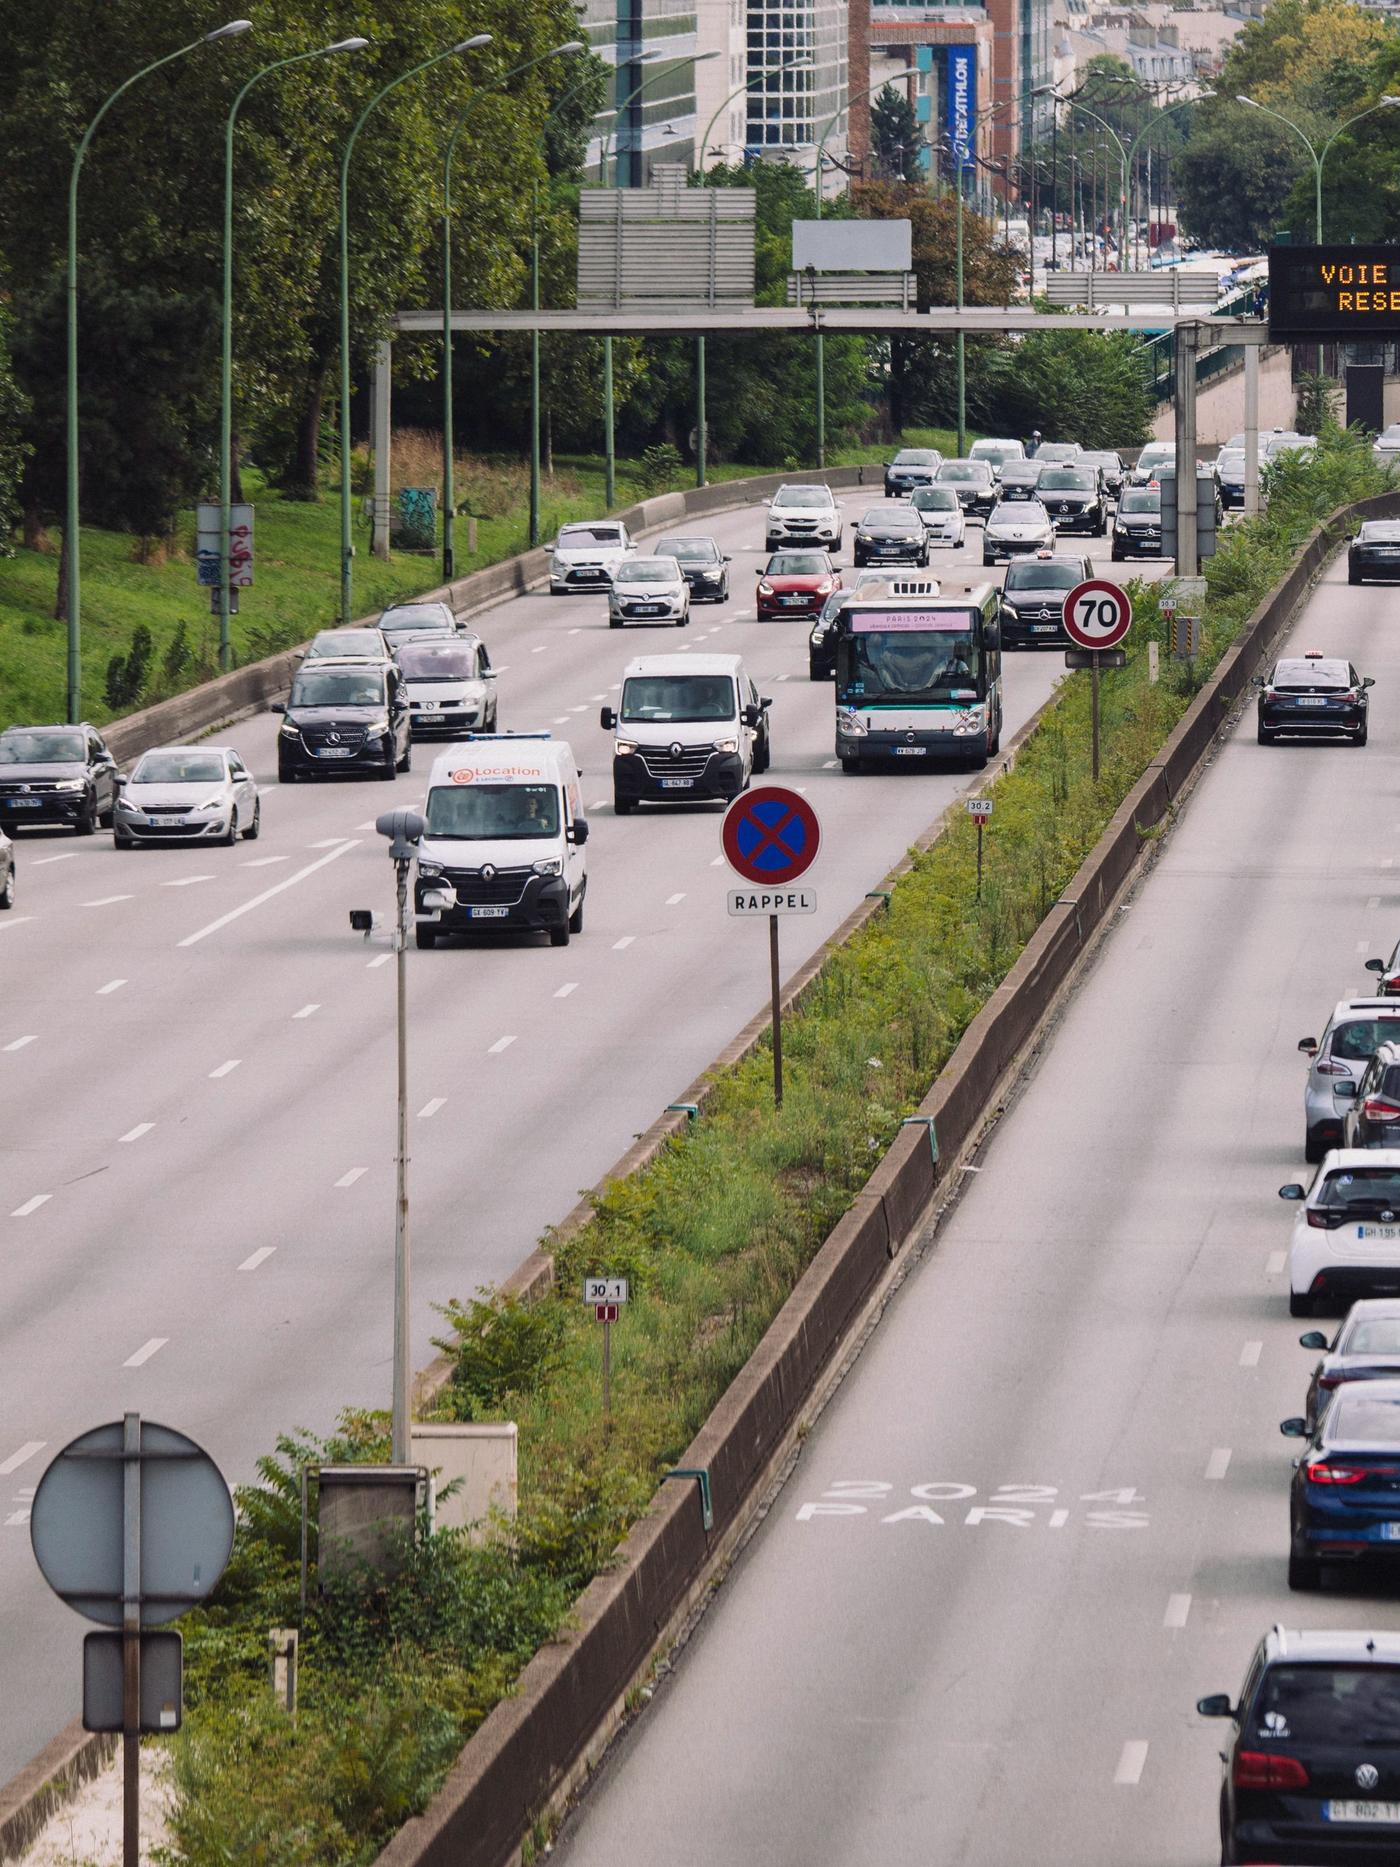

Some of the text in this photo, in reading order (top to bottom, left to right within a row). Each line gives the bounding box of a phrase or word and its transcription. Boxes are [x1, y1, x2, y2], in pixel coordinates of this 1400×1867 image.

[1321, 265, 1387, 284] VOIE
[1079, 599, 1118, 628] 70
[475, 767, 541, 776] Location
[970, 802, 990, 810] 30.2
[735, 894, 810, 909] RAPPEL
[820, 1480, 1147, 1505] 2024
[795, 1502, 1152, 1529] PARIS
